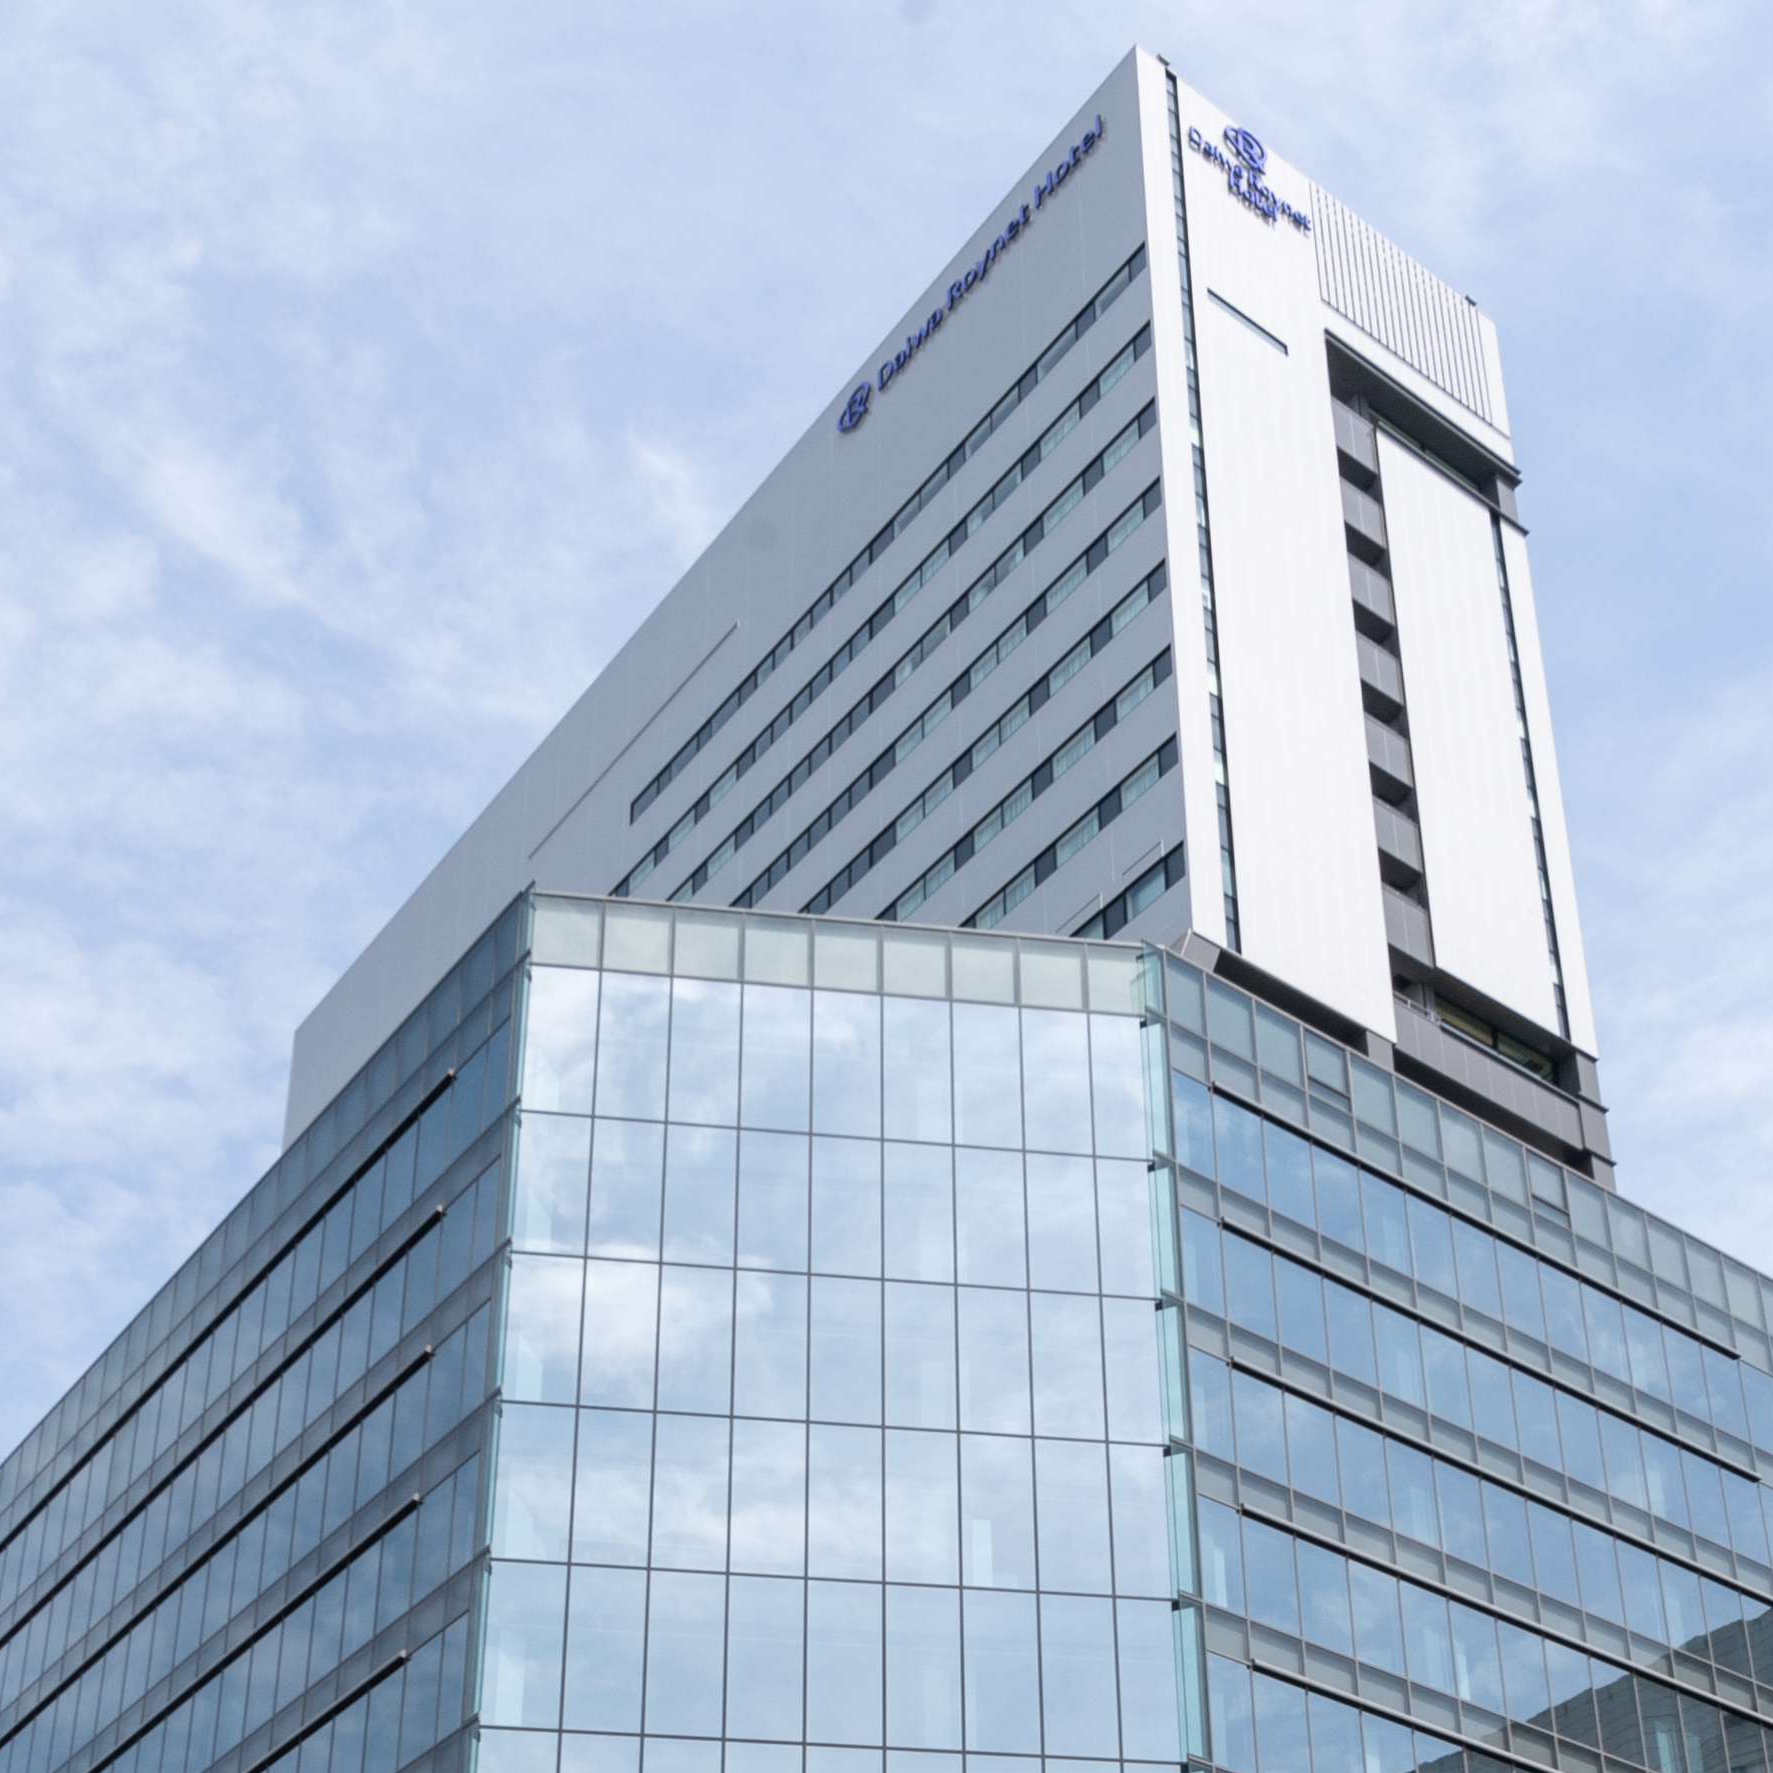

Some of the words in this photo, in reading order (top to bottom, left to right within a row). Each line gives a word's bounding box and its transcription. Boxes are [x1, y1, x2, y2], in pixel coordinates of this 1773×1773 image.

[1188, 125, 1244, 179] Daiwa
[1248, 168, 1311, 232] Roynet
[1229, 170, 1278, 222] Hotel
[877, 306, 943, 390] Daiwa
[946, 203, 1030, 311] Roynet
[1034, 114, 1103, 209] Hotel
